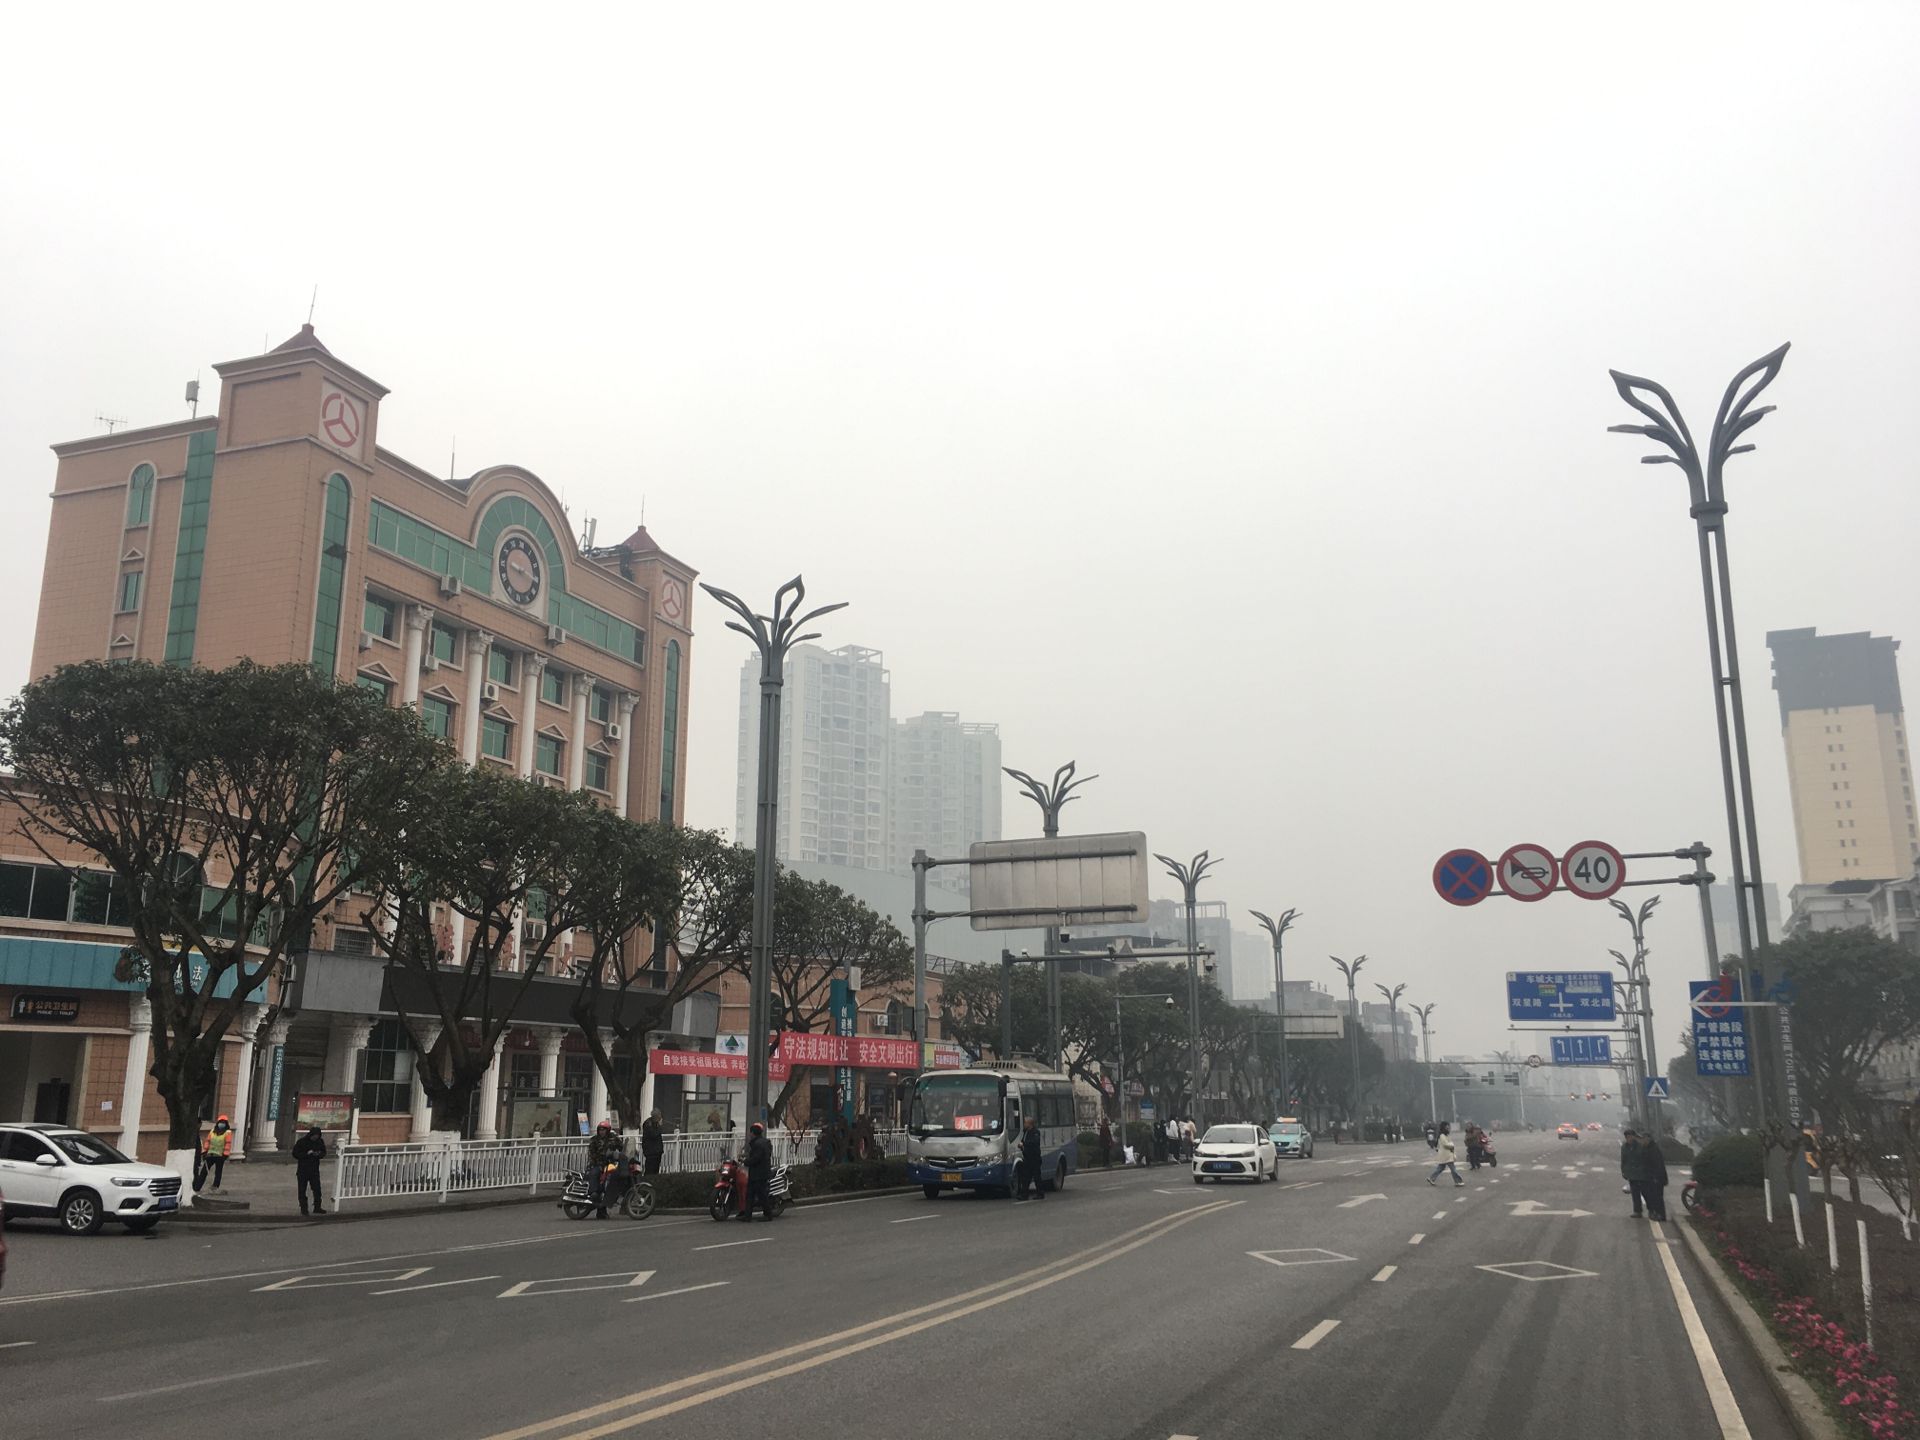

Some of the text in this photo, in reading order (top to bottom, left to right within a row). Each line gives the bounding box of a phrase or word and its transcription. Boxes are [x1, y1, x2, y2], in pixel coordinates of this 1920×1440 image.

[1574, 856, 1611, 884] 40
[1696, 1021, 1743, 1033] 严管路段
[784, 1036, 849, 1061] 守法规知礼让
[1698, 1035, 1744, 1047] 严禁乱停
[663, 1053, 728, 1069] 自觉接受祖国挑选
[1699, 1049, 1746, 1060] 违者拖移
[955, 1115, 983, 1130] 永川
